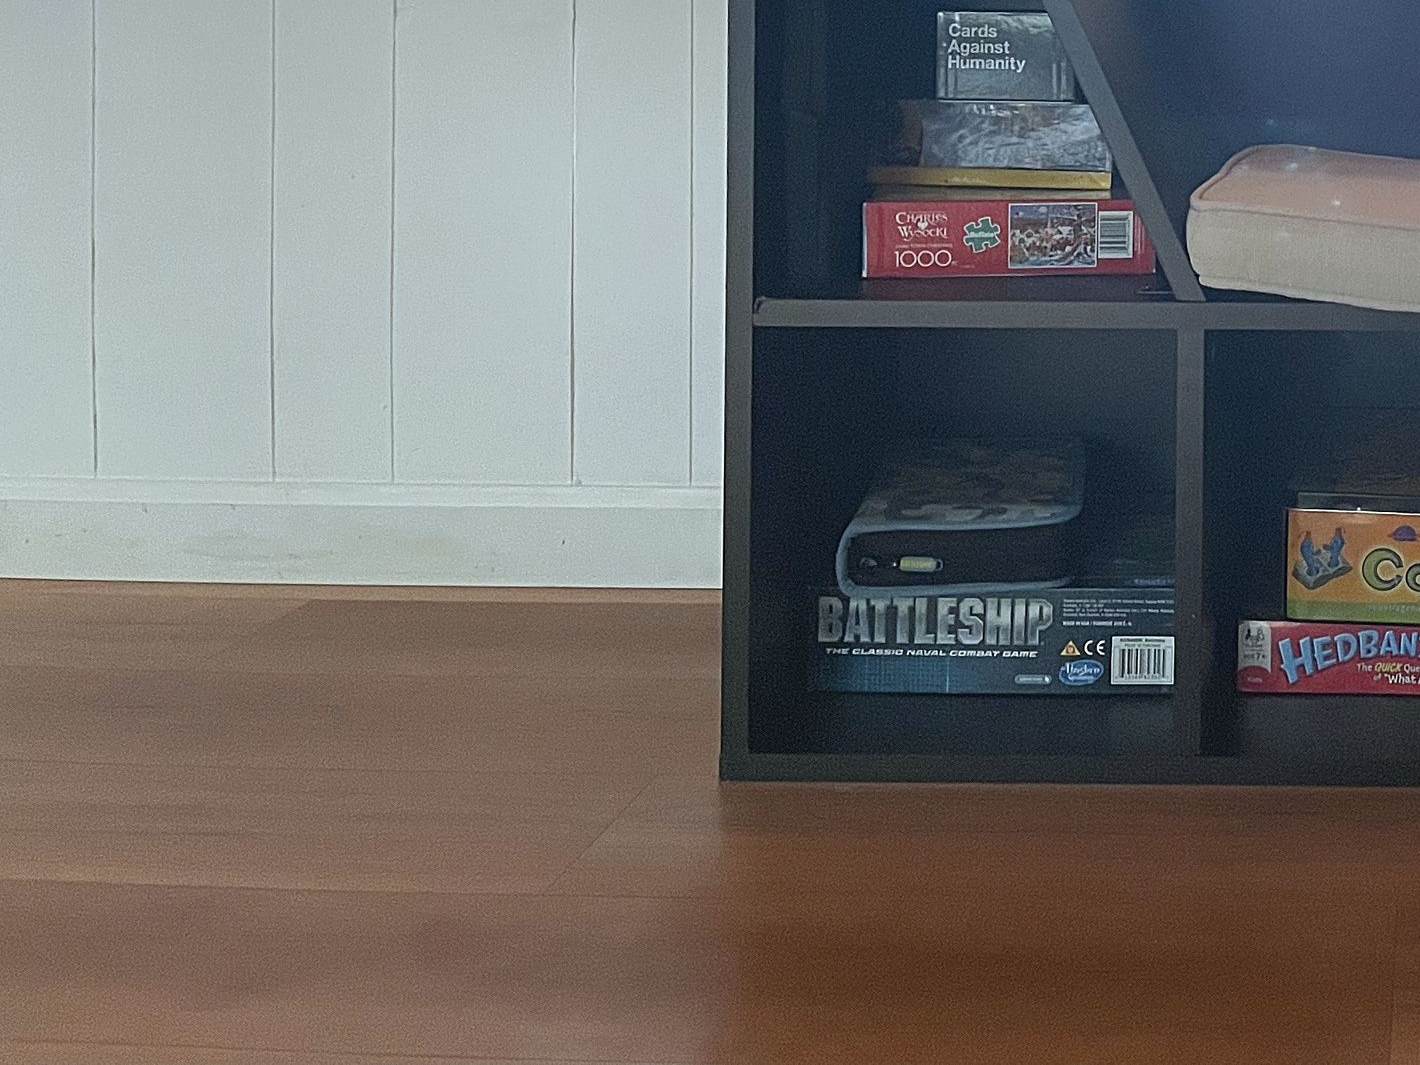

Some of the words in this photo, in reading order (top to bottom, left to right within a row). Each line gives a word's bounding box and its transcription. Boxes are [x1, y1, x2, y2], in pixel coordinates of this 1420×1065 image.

[948, 23, 998, 38] Cards
[947, 39, 1010, 56] Against
[947, 55, 1026, 73] Humanity
[894, 249, 953, 268] 1000
[817, 595, 1053, 646] BATTLESHIP
[825, 647, 850, 655] THE
[852, 648, 904, 656] CLASSIC
[1357, 663, 1373, 673] The
[1374, 662, 1402, 673] QUICK
